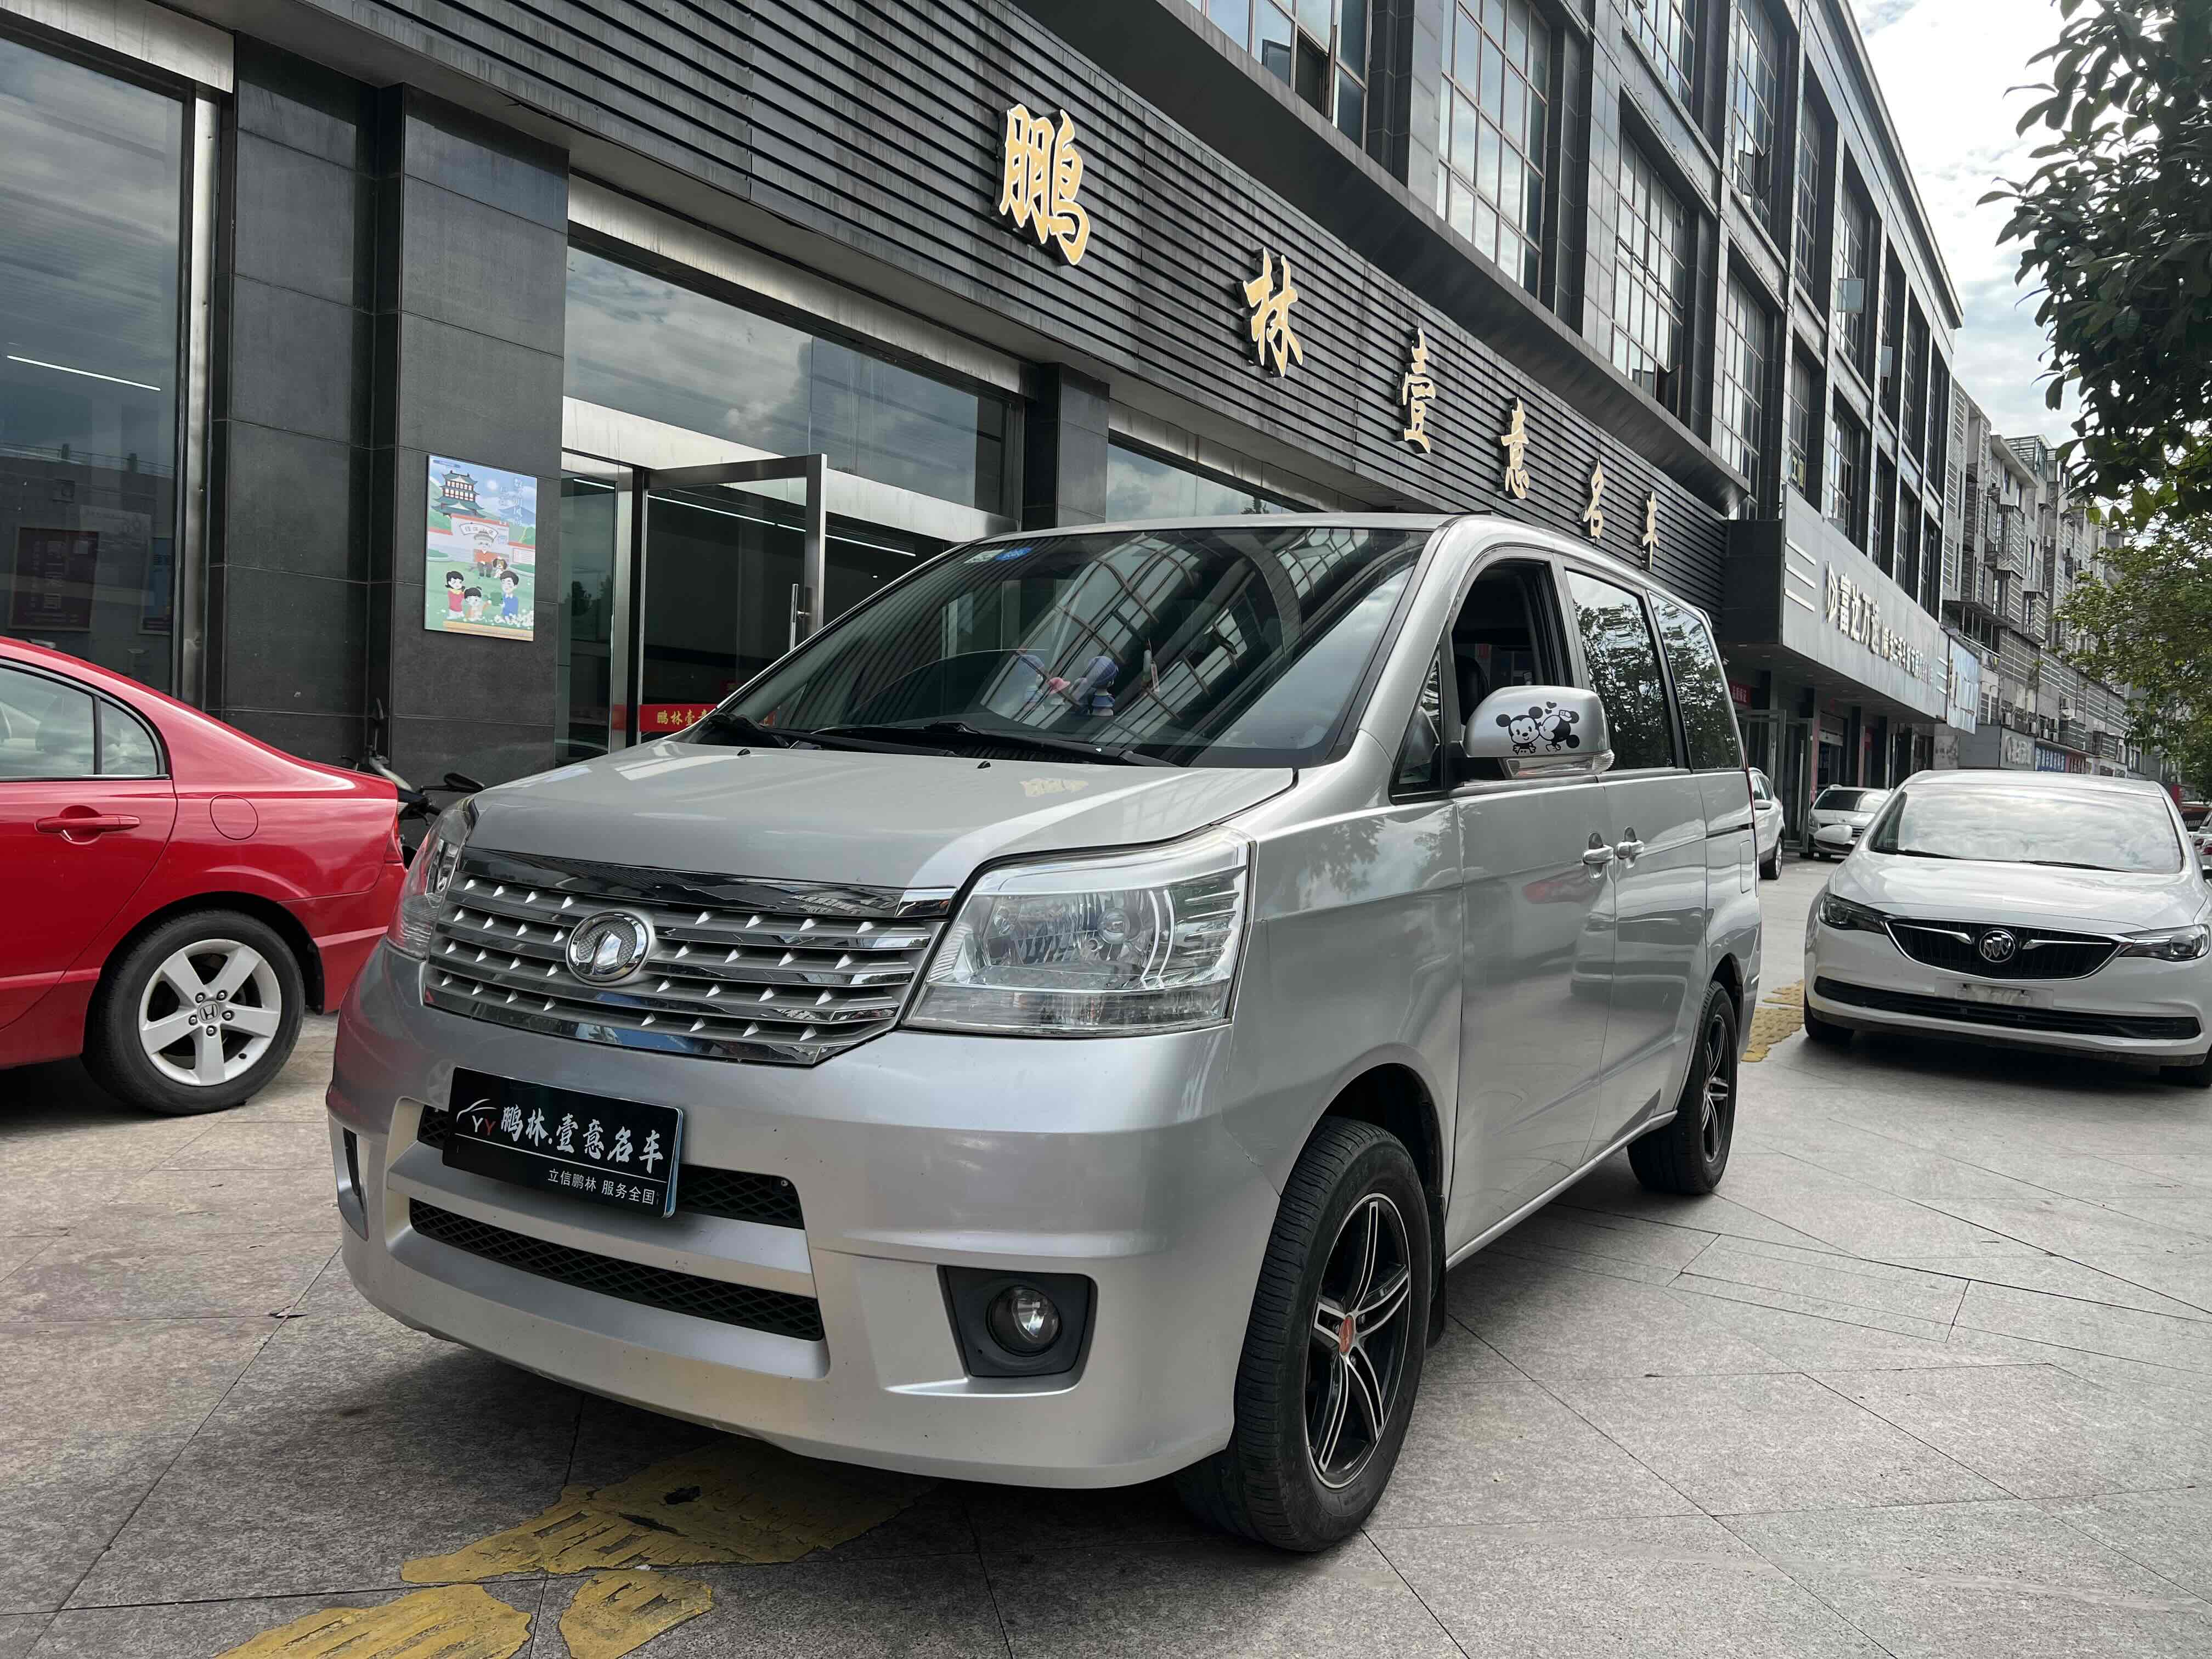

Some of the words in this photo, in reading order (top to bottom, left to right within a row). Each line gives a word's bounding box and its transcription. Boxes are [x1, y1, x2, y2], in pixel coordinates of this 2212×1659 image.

[999, 103, 1659, 571] 鹏林壹意名车
[548, 1168, 597, 1192] 立信鹏林
[601, 1180, 655, 1205] 服务全国
